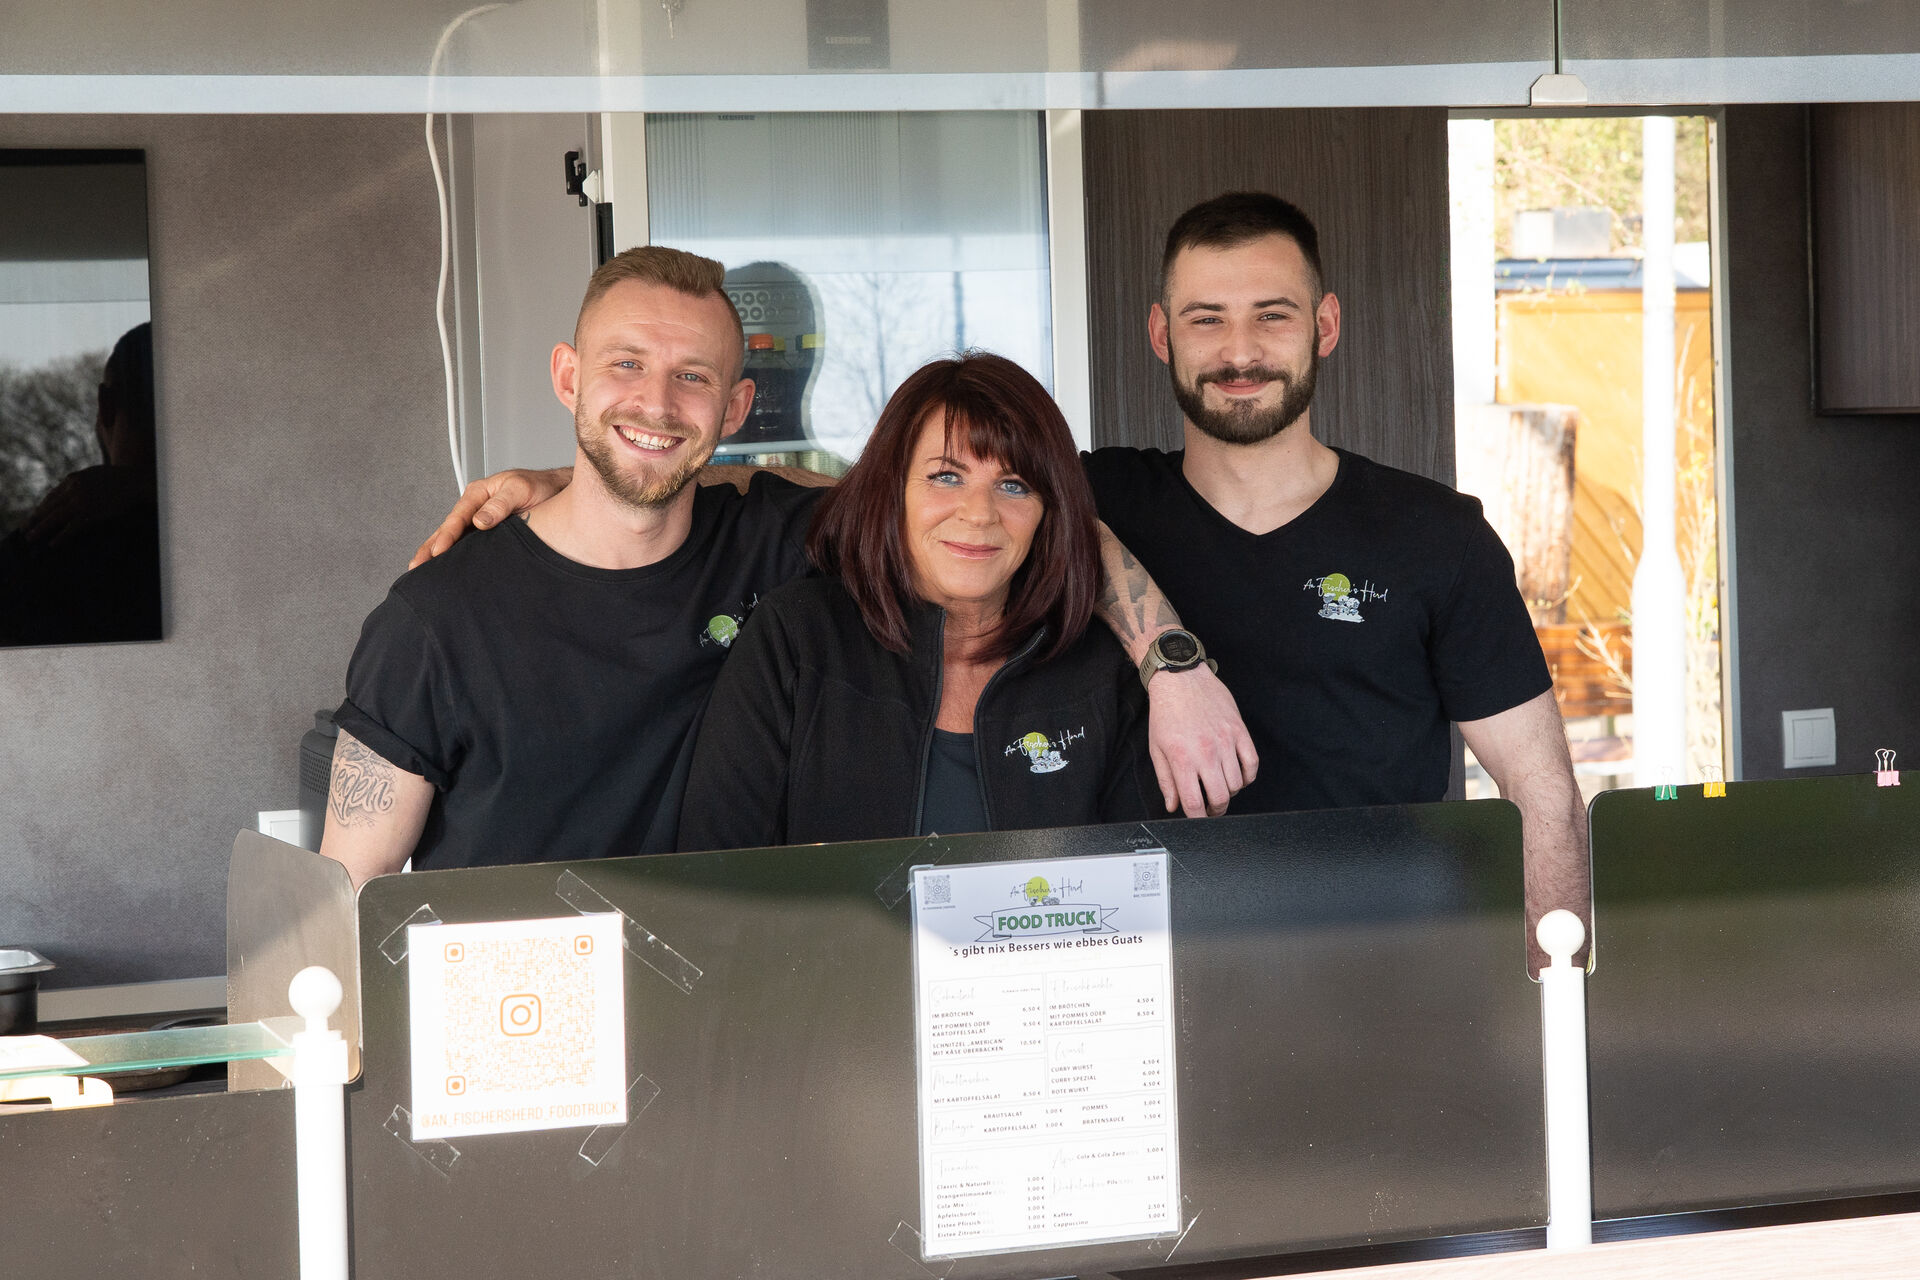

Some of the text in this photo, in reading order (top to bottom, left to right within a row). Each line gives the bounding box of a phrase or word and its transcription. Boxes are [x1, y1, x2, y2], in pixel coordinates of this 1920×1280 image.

[1360, 580, 1388, 602] Herd
[998, 911, 1096, 931] FOOD TRUCK
[962, 945, 984, 958] gibt
[988, 944, 1005, 953] nix
[1009, 942, 1050, 952] Bessers
[1054, 939, 1072, 949] wie
[1076, 937, 1108, 947] ebbes
[1112, 935, 1142, 945] Guats
[1050, 1018, 1102, 1026] KARTOFFELSALAT
[932, 1028, 986, 1037] KARTOFFELSALAT
[963, 1046, 1003, 1054] ÜBERBACKEN
[946, 1094, 1001, 1103] KARTOFFELSALAT
[420, 1102, 618, 1128] @AN_FISCHERSHERD_FOODTRUCK
[1082, 1116, 1125, 1125] BRATENSAUCE
[984, 1124, 1037, 1133] KARTOFFELSALAT
[937, 1190, 992, 1200] Orangenlimonade
[938, 1211, 976, 1219] Apfelschorle
